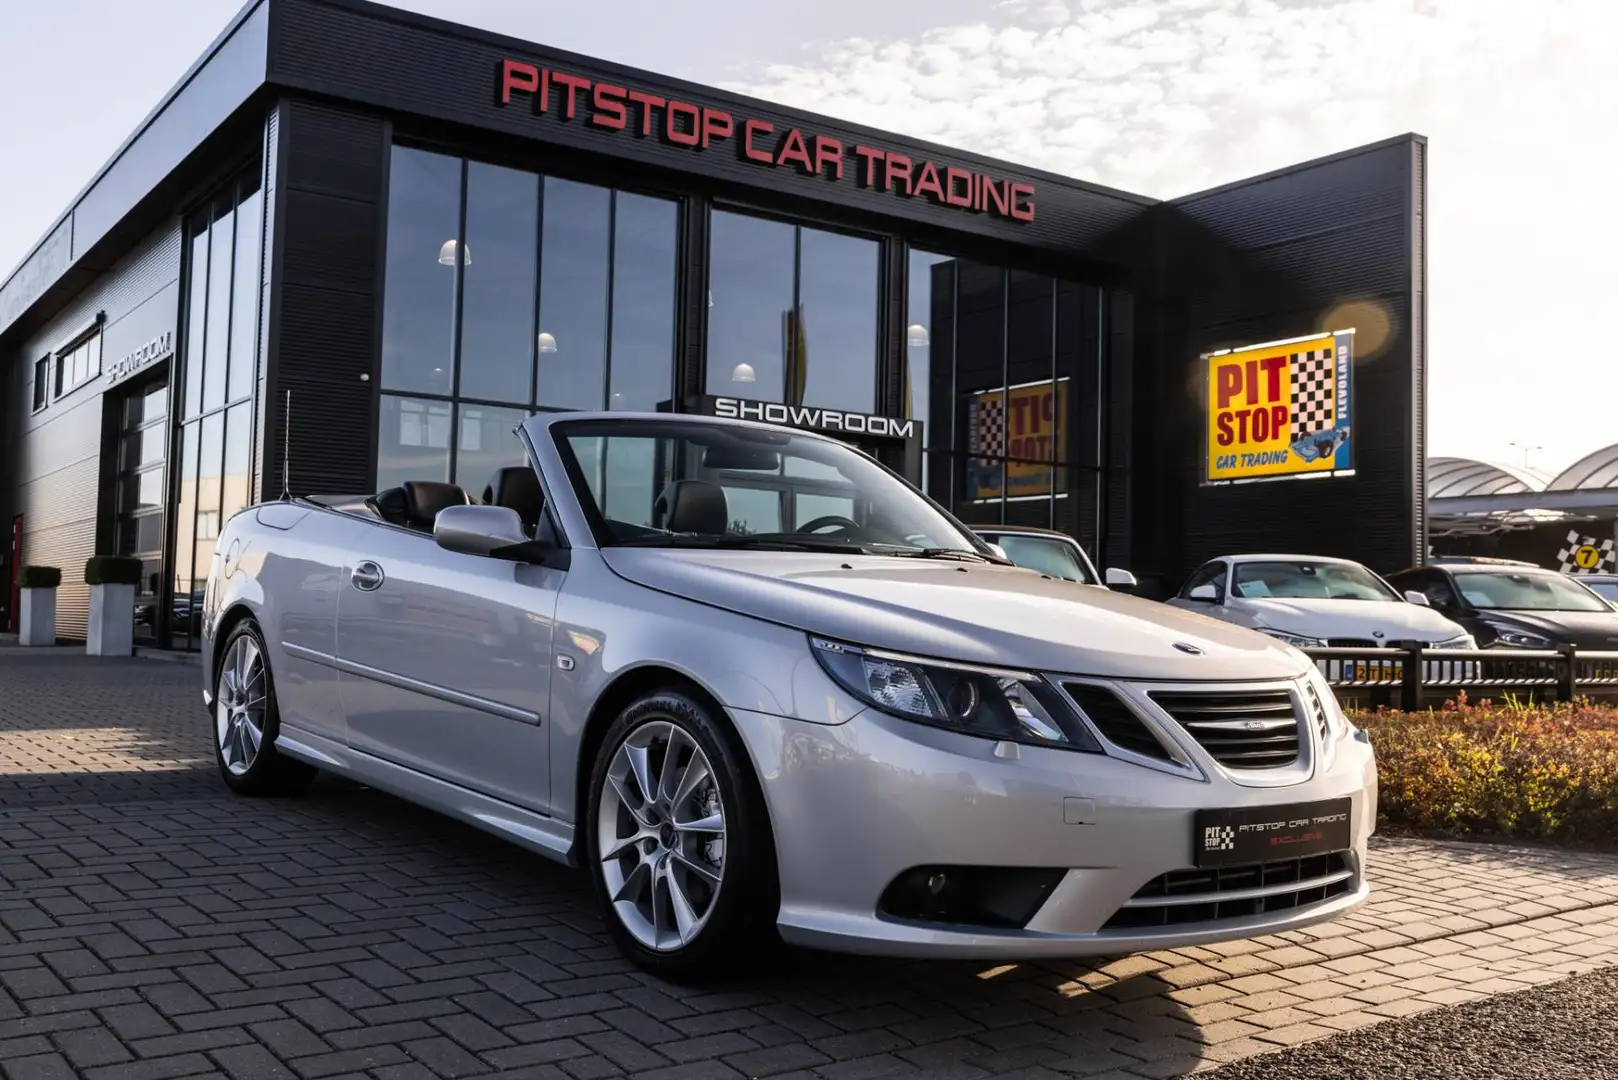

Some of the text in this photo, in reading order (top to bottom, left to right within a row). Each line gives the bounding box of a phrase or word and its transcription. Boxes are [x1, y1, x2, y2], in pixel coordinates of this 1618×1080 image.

[501, 59, 1036, 222] PITSTOP CAR TRADING
[106, 331, 171, 385] SHOWROOM
[1217, 355, 1288, 409] PIT
[1337, 345, 1348, 420] FLEVOLAND
[715, 397, 914, 438] SHOWROOM
[1217, 405, 1288, 446] STOP
[1216, 450, 1289, 470] CAR TRADING
[1581, 549, 1593, 565] 7
[1204, 837, 1221, 847] STOP
[1205, 826, 1221, 838] PIT
[1239, 813, 1347, 832] PITSTOP CAR TRADING
